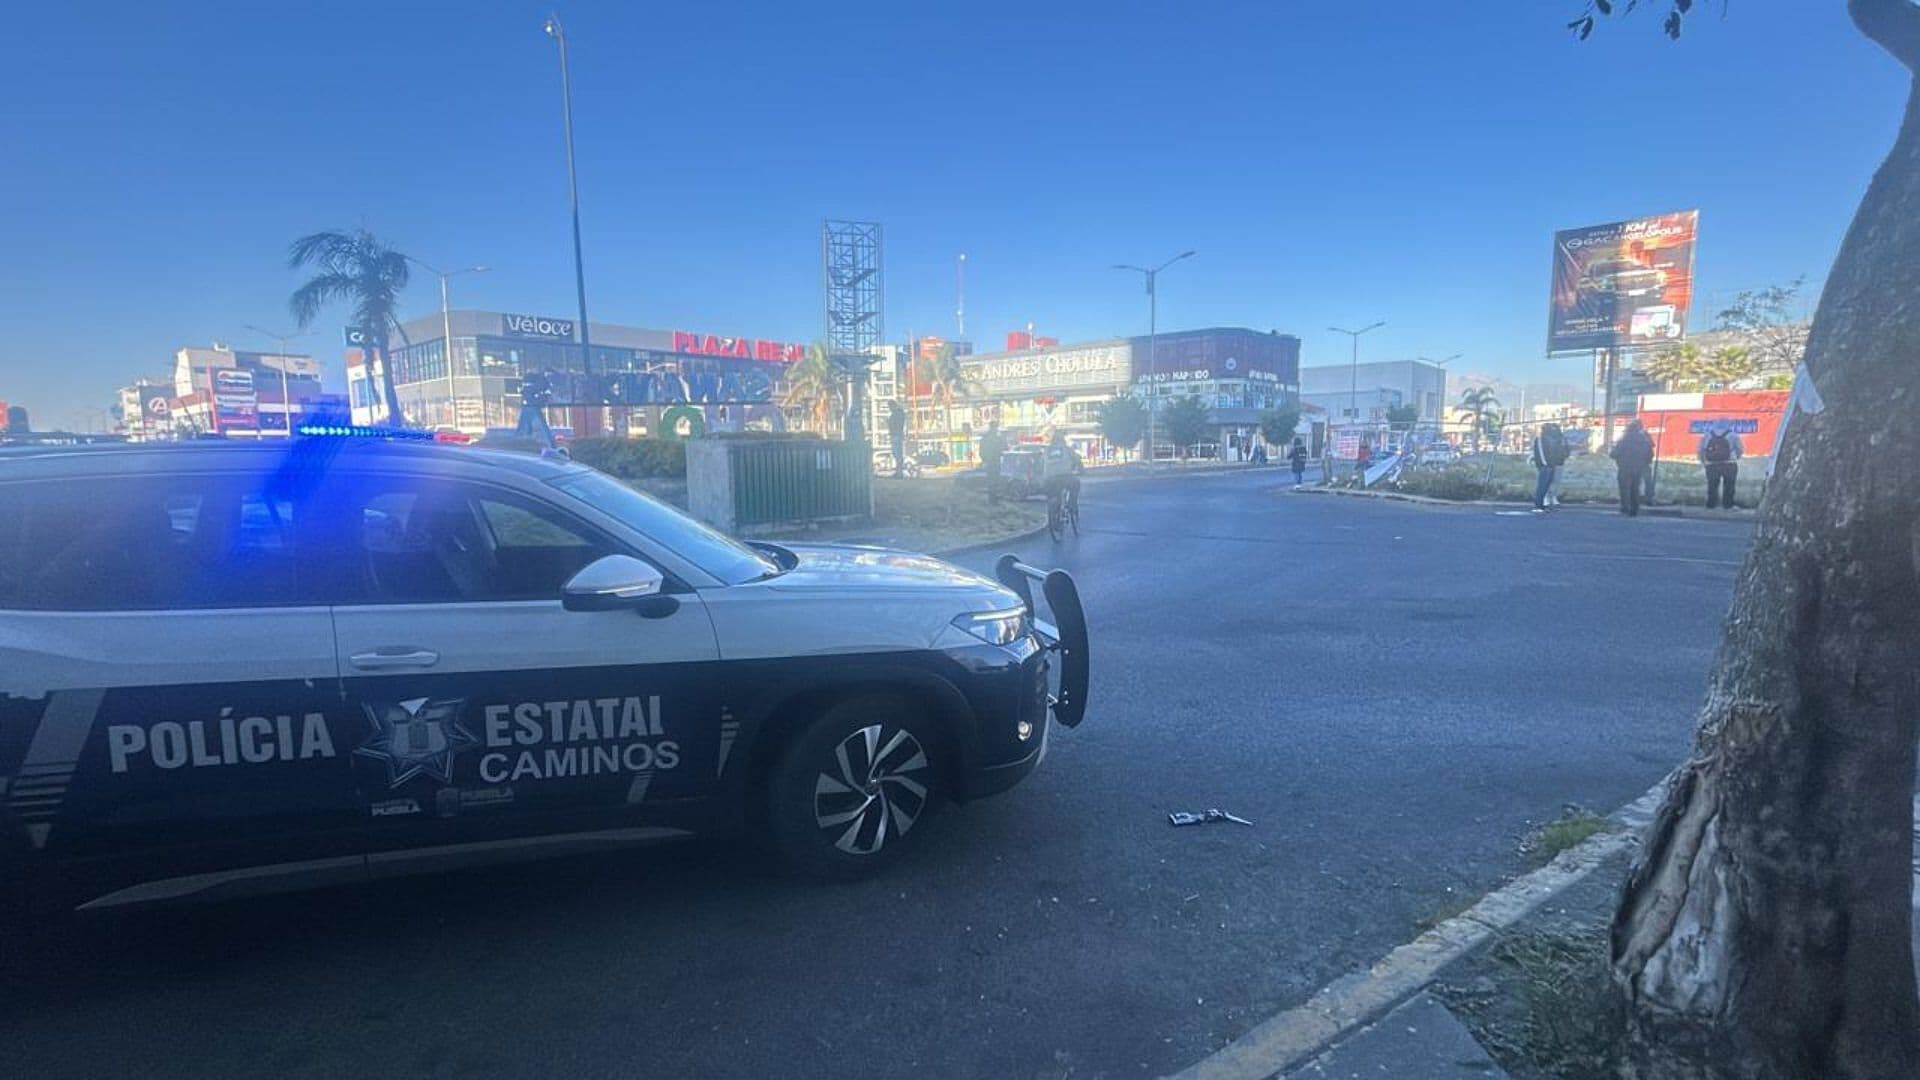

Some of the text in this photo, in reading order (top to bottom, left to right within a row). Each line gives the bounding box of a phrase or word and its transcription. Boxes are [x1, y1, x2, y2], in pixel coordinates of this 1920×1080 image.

[507, 315, 571, 336] Véloce
[673, 330, 751, 359] PLAZA
[1045, 351, 1117, 375] CHOLULA
[485, 695, 664, 747] ESTATAL
[108, 707, 336, 773] POLÍCIA
[479, 741, 681, 783] CAMINOS
